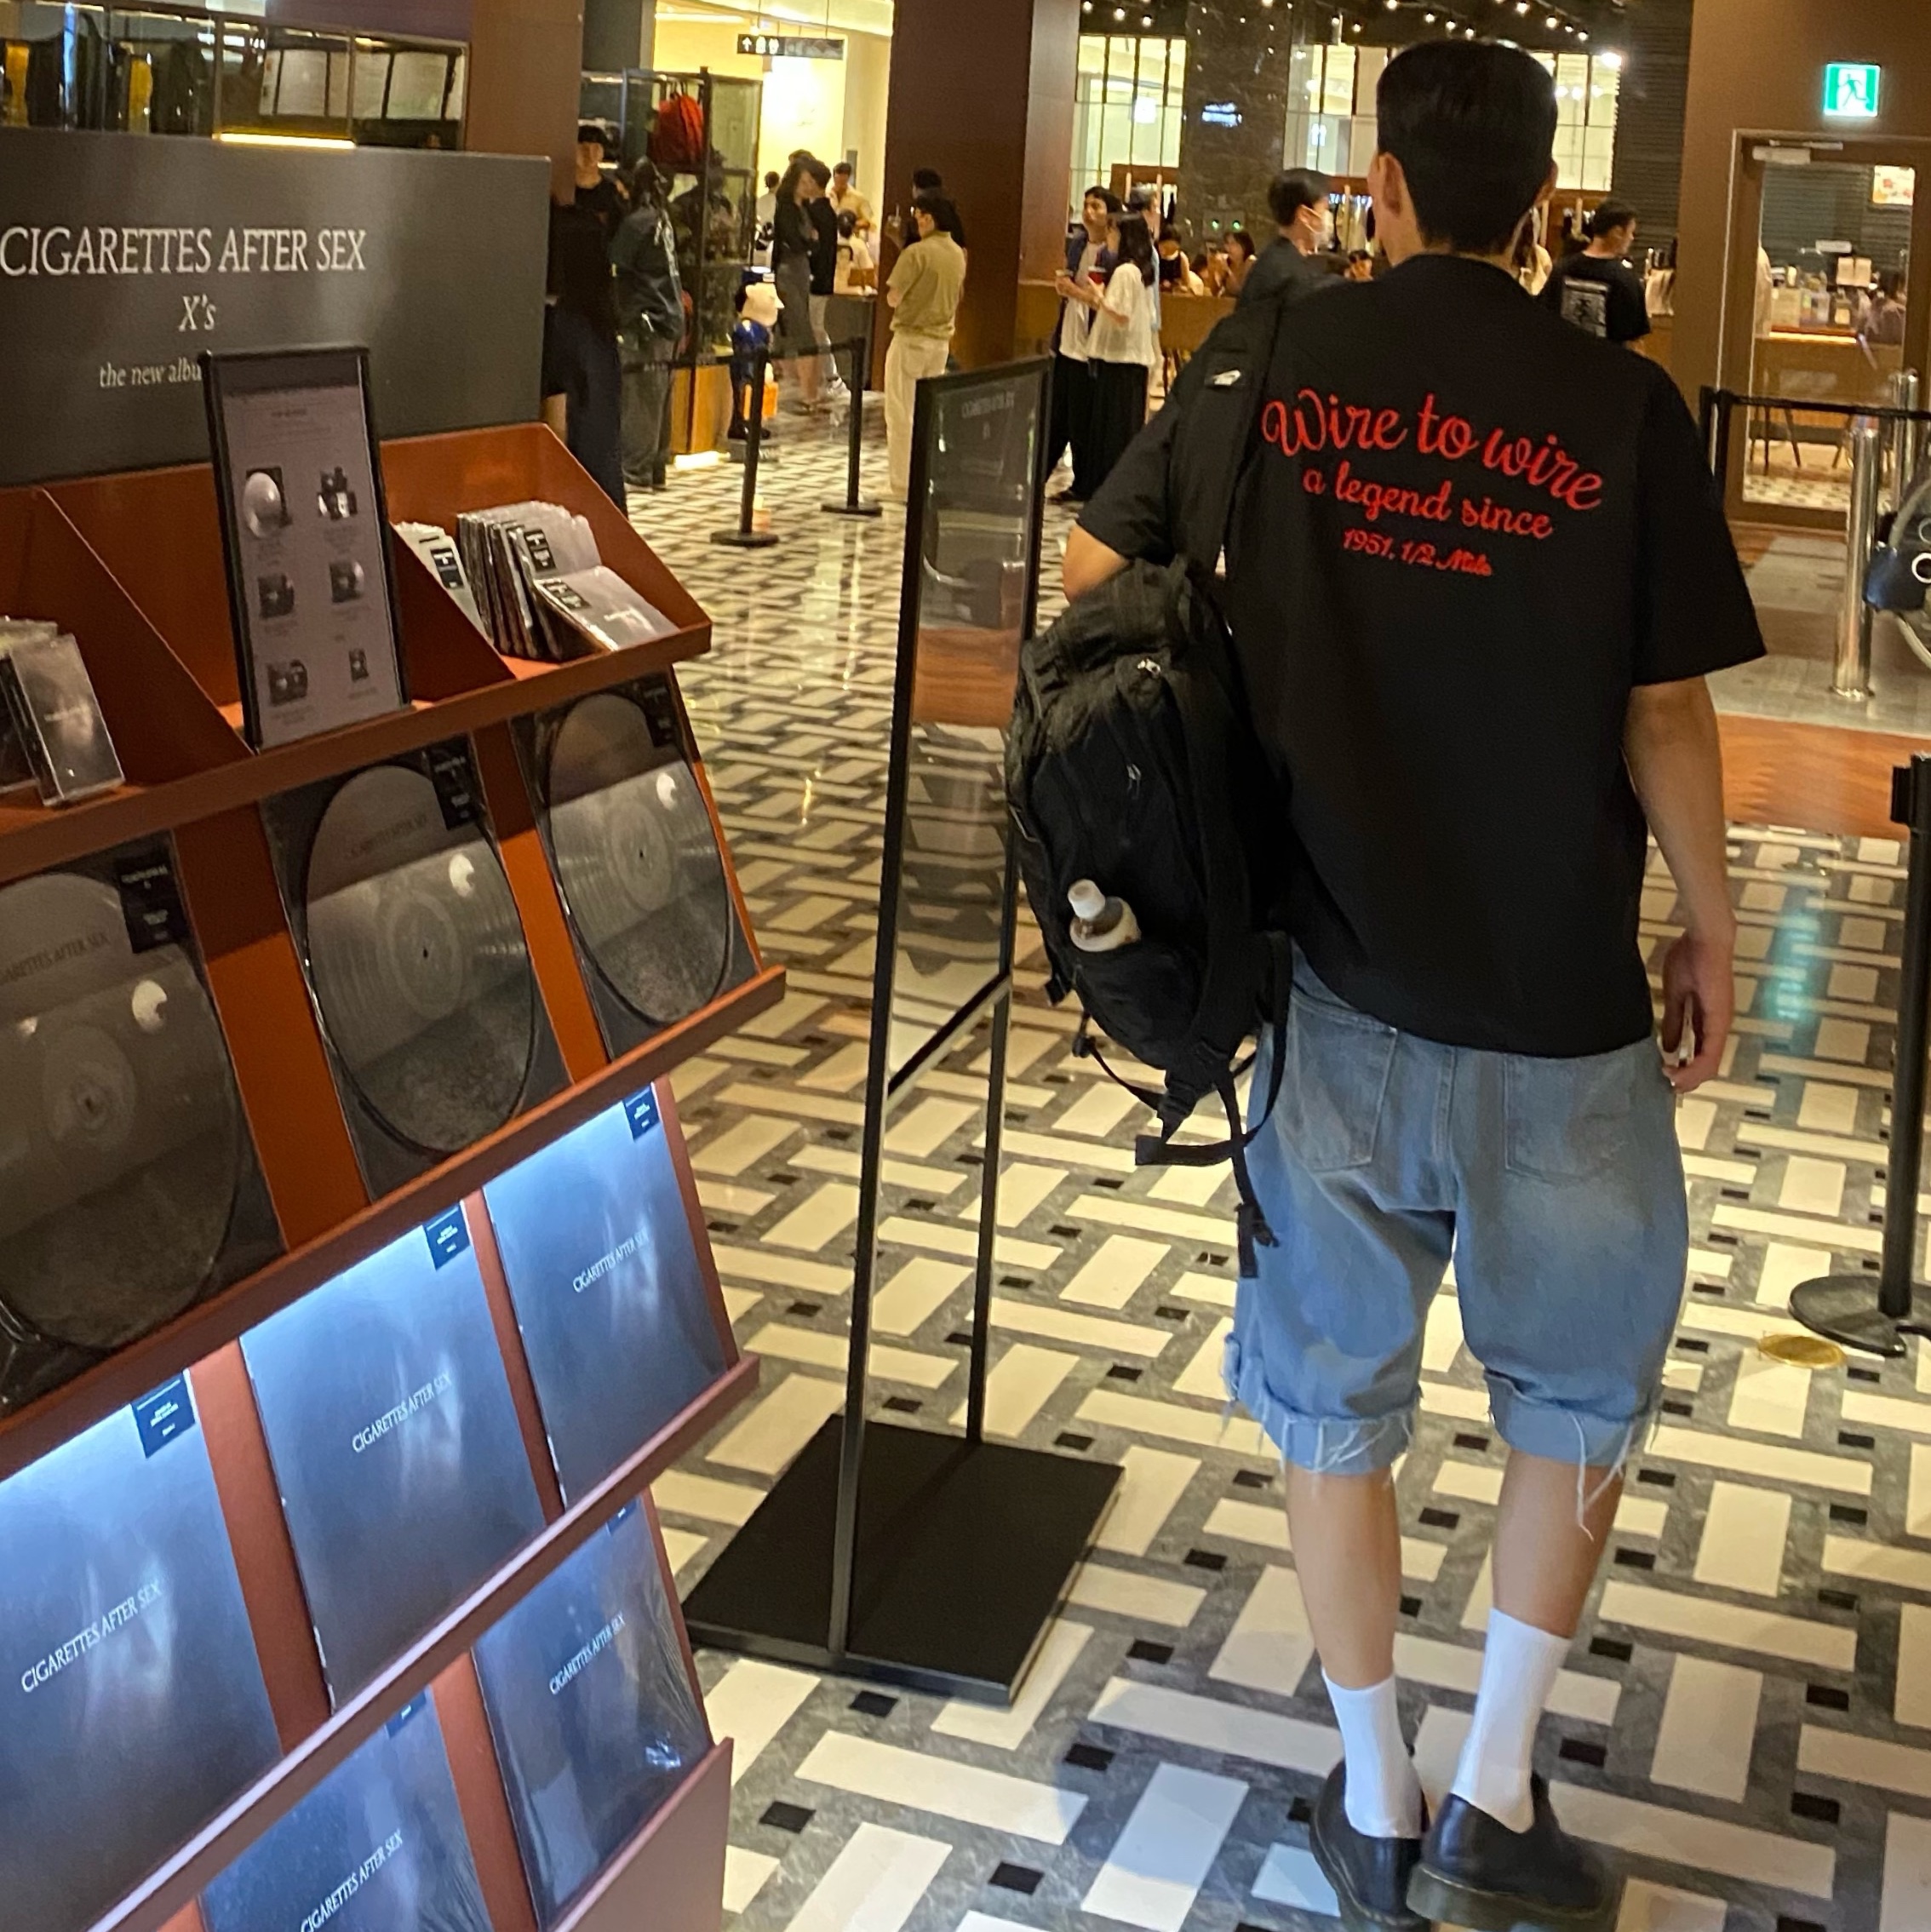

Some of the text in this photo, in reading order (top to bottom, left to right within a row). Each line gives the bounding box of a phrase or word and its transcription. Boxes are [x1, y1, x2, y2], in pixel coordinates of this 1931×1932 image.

[0, 226, 367, 277] CIGARETTES AFTER SEX
[178, 294, 216, 332] X's
[100, 356, 202, 388] the new albu
[1261, 387, 1602, 510] Wire to wire
[1303, 460, 1554, 539] a legend since
[572, 1250, 616, 1293] CIGARETTES
[352, 1372, 452, 1453] CIGARETTES AFTER SEX
[20, 1577, 163, 1694] CIGARETTES AFTER SEX
[548, 1642, 593, 1695] CIGARETTES
[301, 1827, 403, 1932] CIGARETTES AFTER SEX
